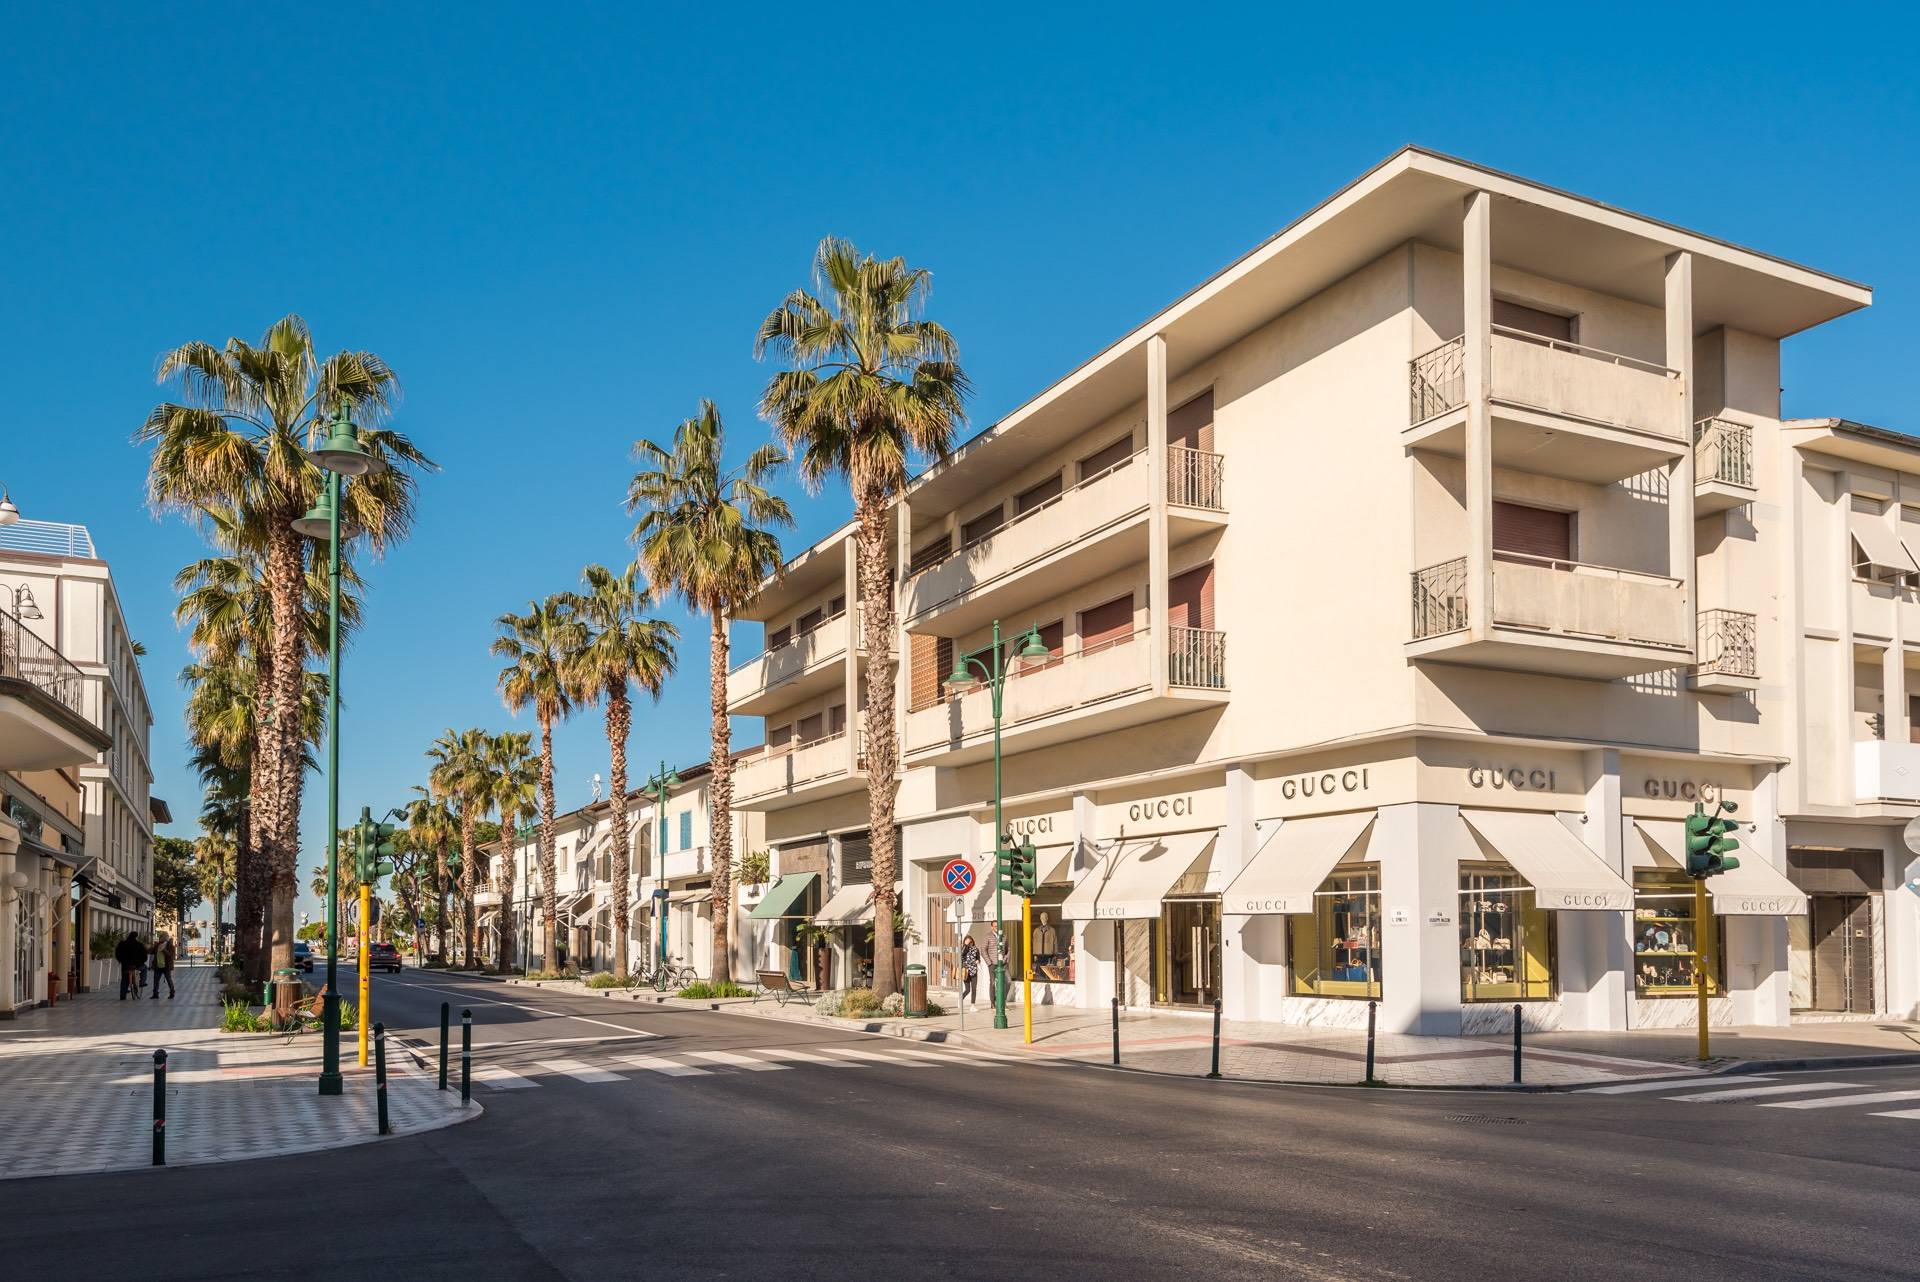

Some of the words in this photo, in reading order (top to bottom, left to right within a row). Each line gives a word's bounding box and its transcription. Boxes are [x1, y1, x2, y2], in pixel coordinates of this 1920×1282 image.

[1282, 768, 1369, 800] GUCCI
[1469, 766, 1556, 791] GUCCI
[1644, 779, 1723, 804] GUCCI
[1129, 796, 1193, 822] GUCCI
[1006, 816, 1053, 836] GUCCI
[1246, 900, 1287, 910] GUCCI
[1564, 895, 1608, 906] GUCCI
[1741, 901, 1781, 912] GUCCI
[1095, 907, 1125, 917] GUCCI
